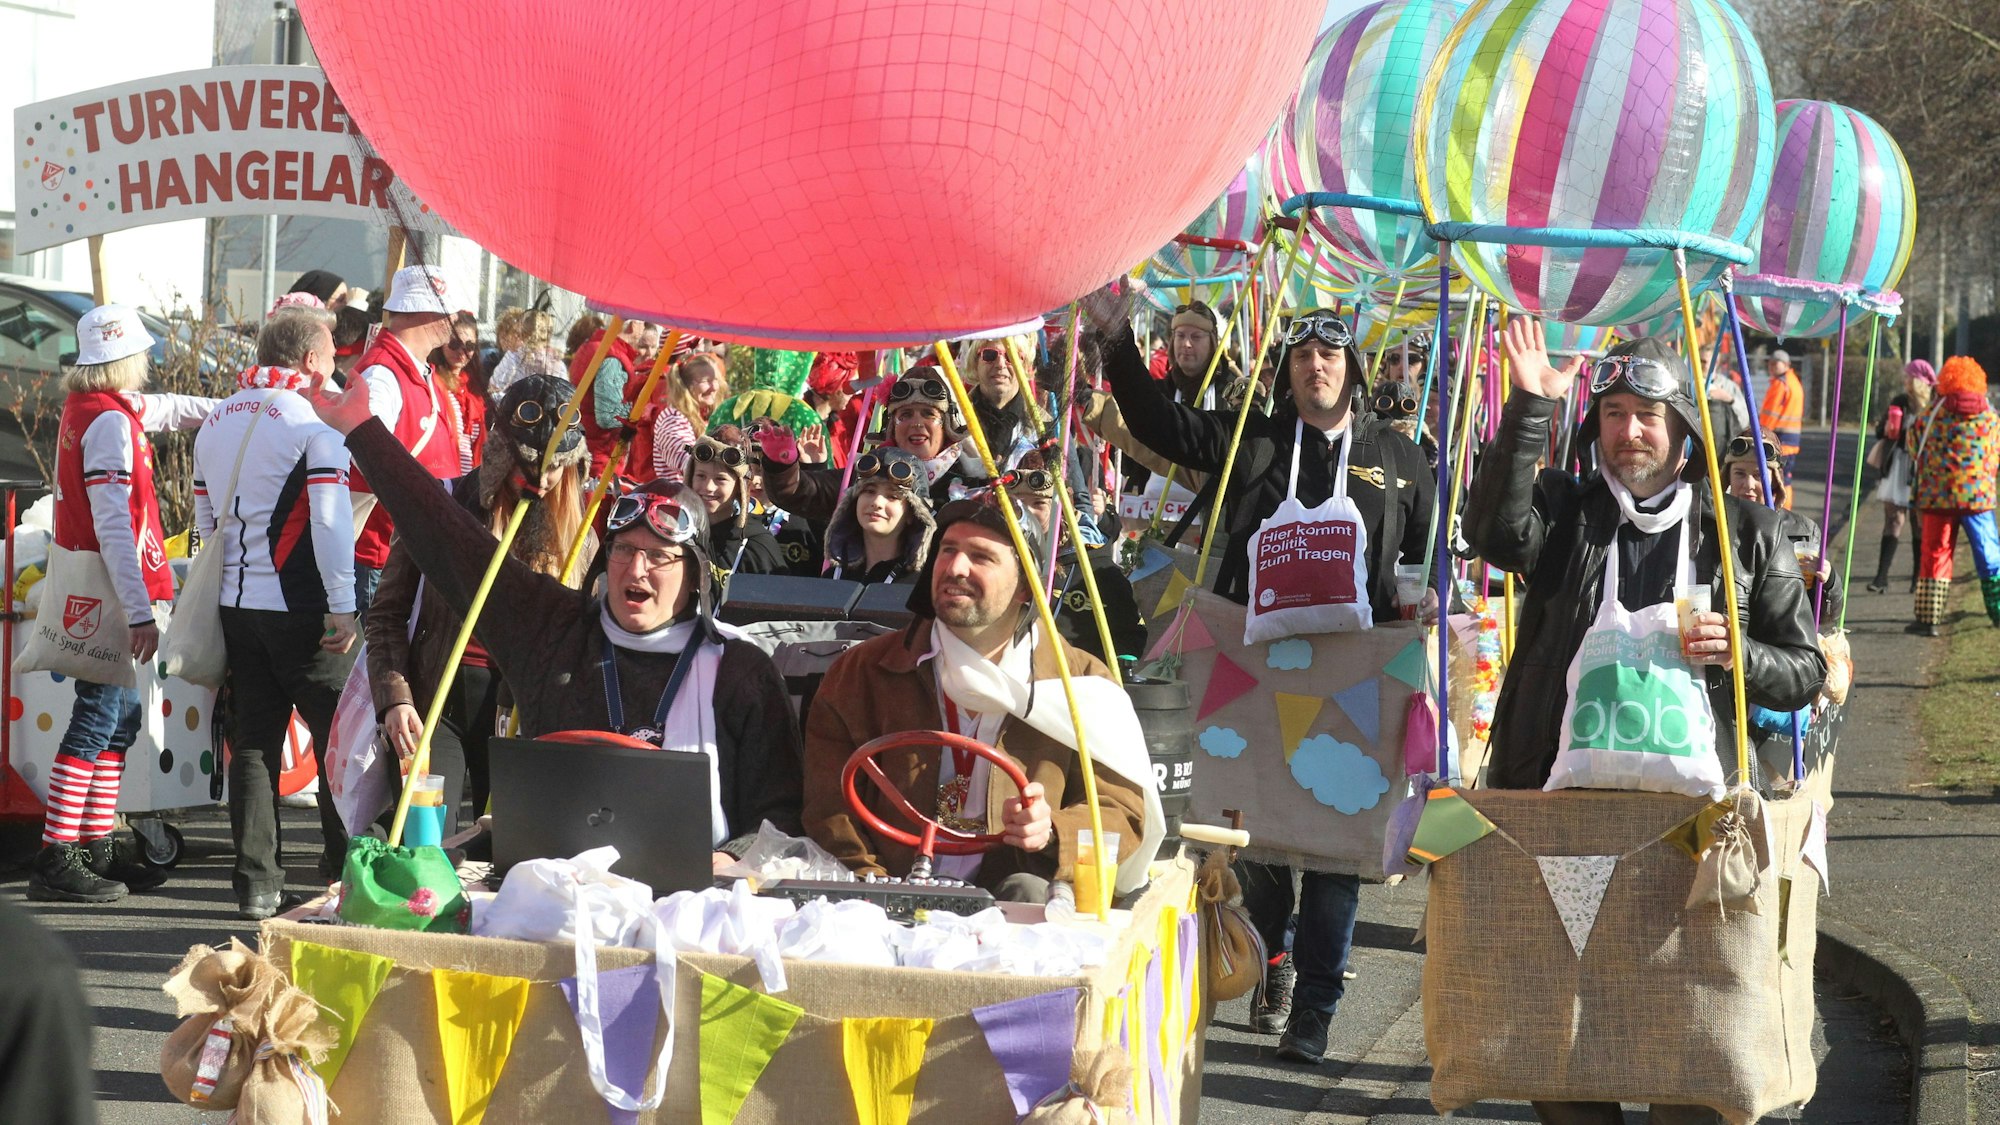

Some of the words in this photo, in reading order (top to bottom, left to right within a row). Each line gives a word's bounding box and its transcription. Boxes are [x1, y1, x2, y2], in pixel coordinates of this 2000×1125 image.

[73, 79, 361, 153] TURNVERE
[118, 150, 394, 214] HANGELAR
[208, 409, 221, 428] TV
[225, 401, 282, 420] Hanglar
[1261, 529, 1293, 545] Hier
[1296, 524, 1352, 537] kommt
[1260, 536, 1308, 558] Politik
[1259, 553, 1291, 572] zum
[1295, 548, 1351, 562] Tragen
[69, 598, 94, 616] TV
[39, 625, 58, 643] Mit
[59, 635, 86, 656] Spaß
[87, 646, 121, 663] dabei!
[1586, 633, 1612, 649] Hier
[1615, 630, 1659, 650] kommt
[1627, 646, 1656, 661] zum
[1658, 646, 1684, 661] Tra
